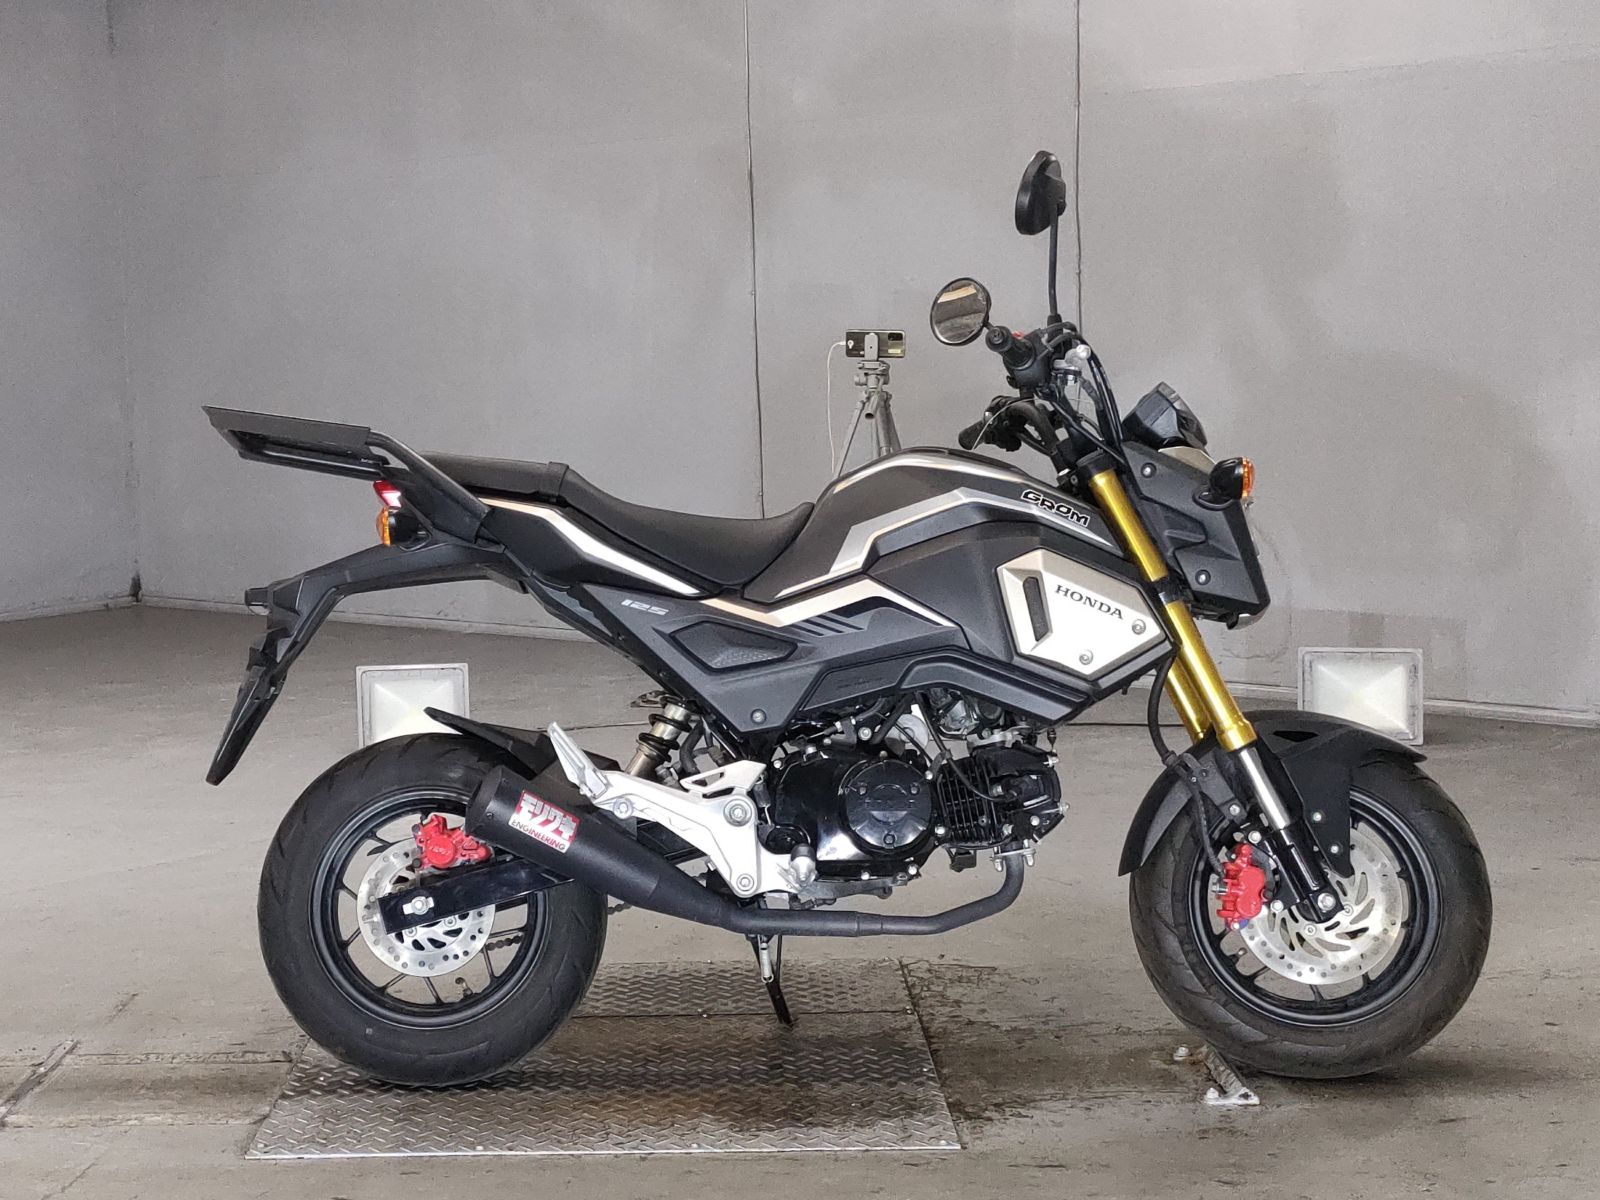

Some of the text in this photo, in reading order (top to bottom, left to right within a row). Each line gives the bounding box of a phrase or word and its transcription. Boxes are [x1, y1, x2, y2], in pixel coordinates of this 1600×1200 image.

[1021, 489, 1090, 527] GROM
[621, 599, 669, 615] 125
[1055, 585, 1124, 620] HONDA
[511, 819, 566, 851] ENGINEERING
